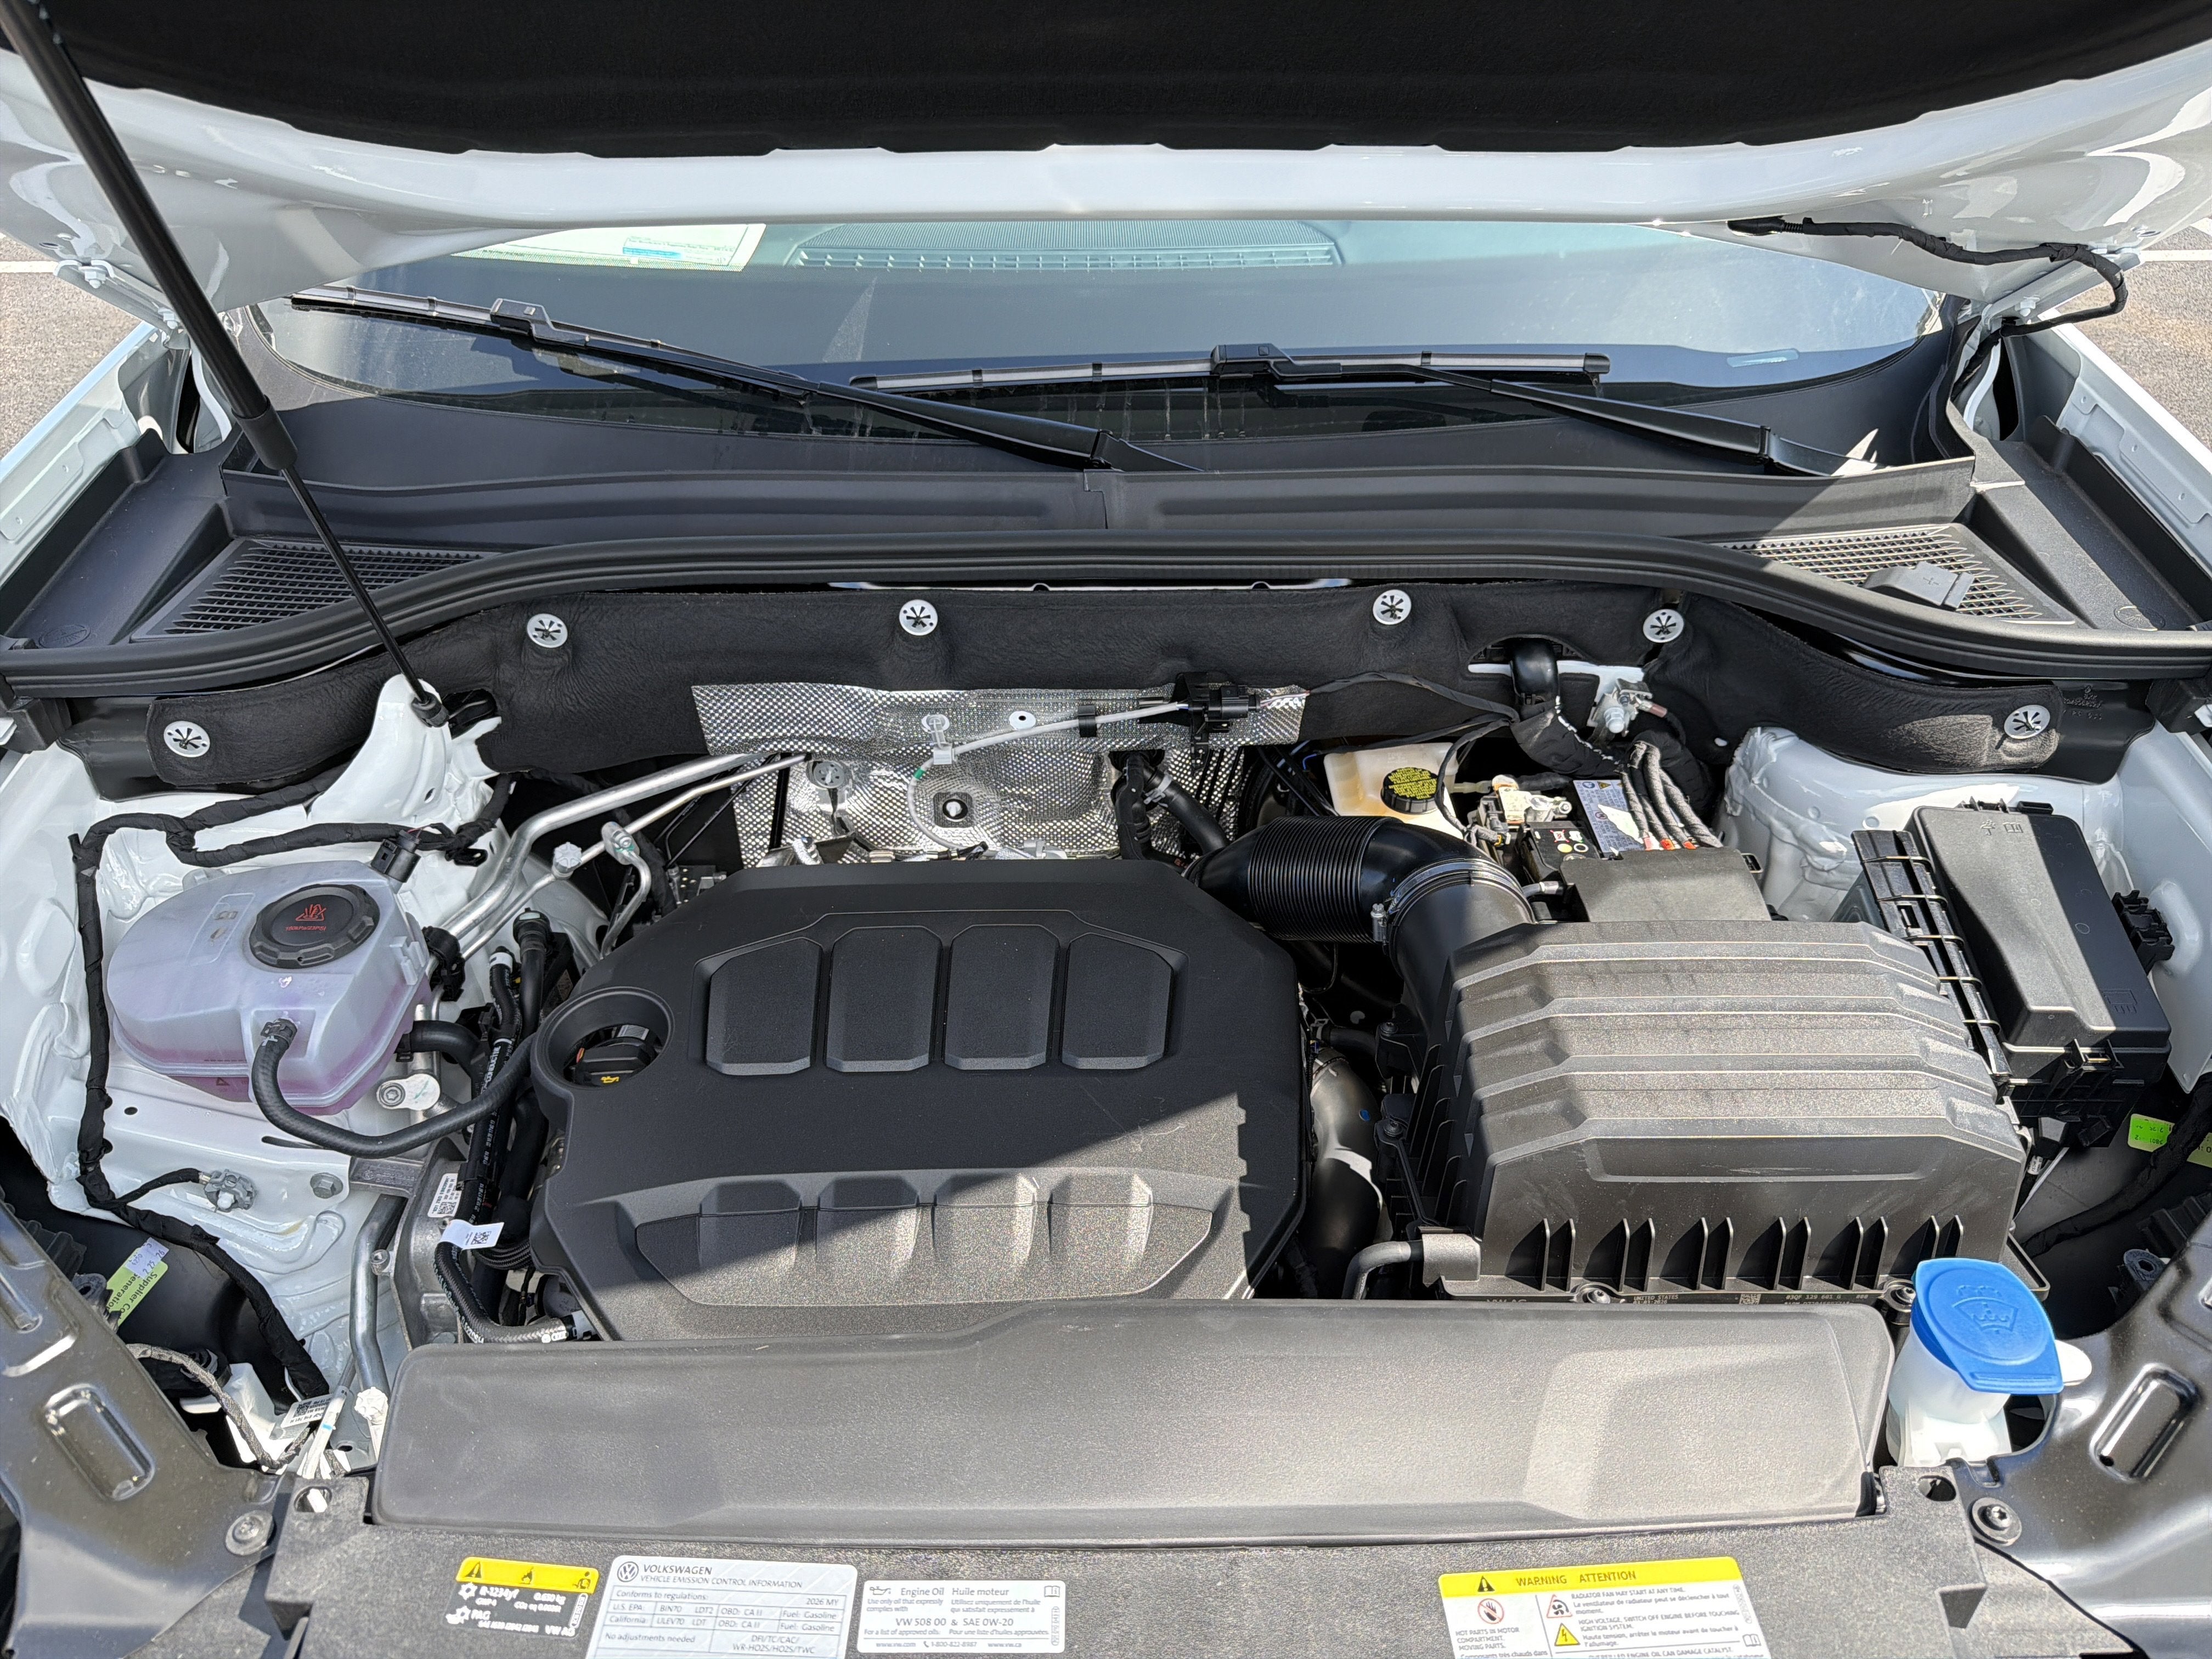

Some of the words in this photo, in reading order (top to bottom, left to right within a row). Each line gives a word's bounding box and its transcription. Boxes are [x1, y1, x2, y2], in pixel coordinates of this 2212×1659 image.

[128, 1271, 159, 1304] Supplier
[643, 1564, 713, 1576] VOLKSWAGEN
[673, 1576, 709, 1585] EMISSION
[712, 1578, 746, 1586] CONTROL
[748, 1579, 803, 1588] INFORMATION
[1515, 1575, 1568, 1587] WARNING
[1578, 1570, 1637, 1583] ATTENTION
[616, 1589, 652, 1598] Conforms
[900, 1587, 930, 1598] Engine
[932, 1587, 945, 1595] Oil
[952, 1587, 975, 1596] Huile
[1571, 1591, 1601, 1600] RADIATOR
[806, 1598, 824, 1606] 2026
[916, 1598, 944, 1606] expressly
[695, 1606, 714, 1615] LDT2
[804, 1612, 837, 1620] Gasoline
[895, 1618, 913, 1626] VW
[914, 1618, 932, 1626] 508
[933, 1618, 947, 1626] 00
[963, 1618, 981, 1627] SAE
[982, 1618, 1014, 1627] 0W-20
[545, 1624, 562, 1635] VW
[561, 1626, 575, 1637] AG
[802, 1623, 835, 1632] Gasoline
[898, 1628, 928, 1637] approved
[617, 1633, 665, 1642] adjustments
[667, 1635, 696, 1643] needed
[1458, 1643, 1485, 1651] MOVING
